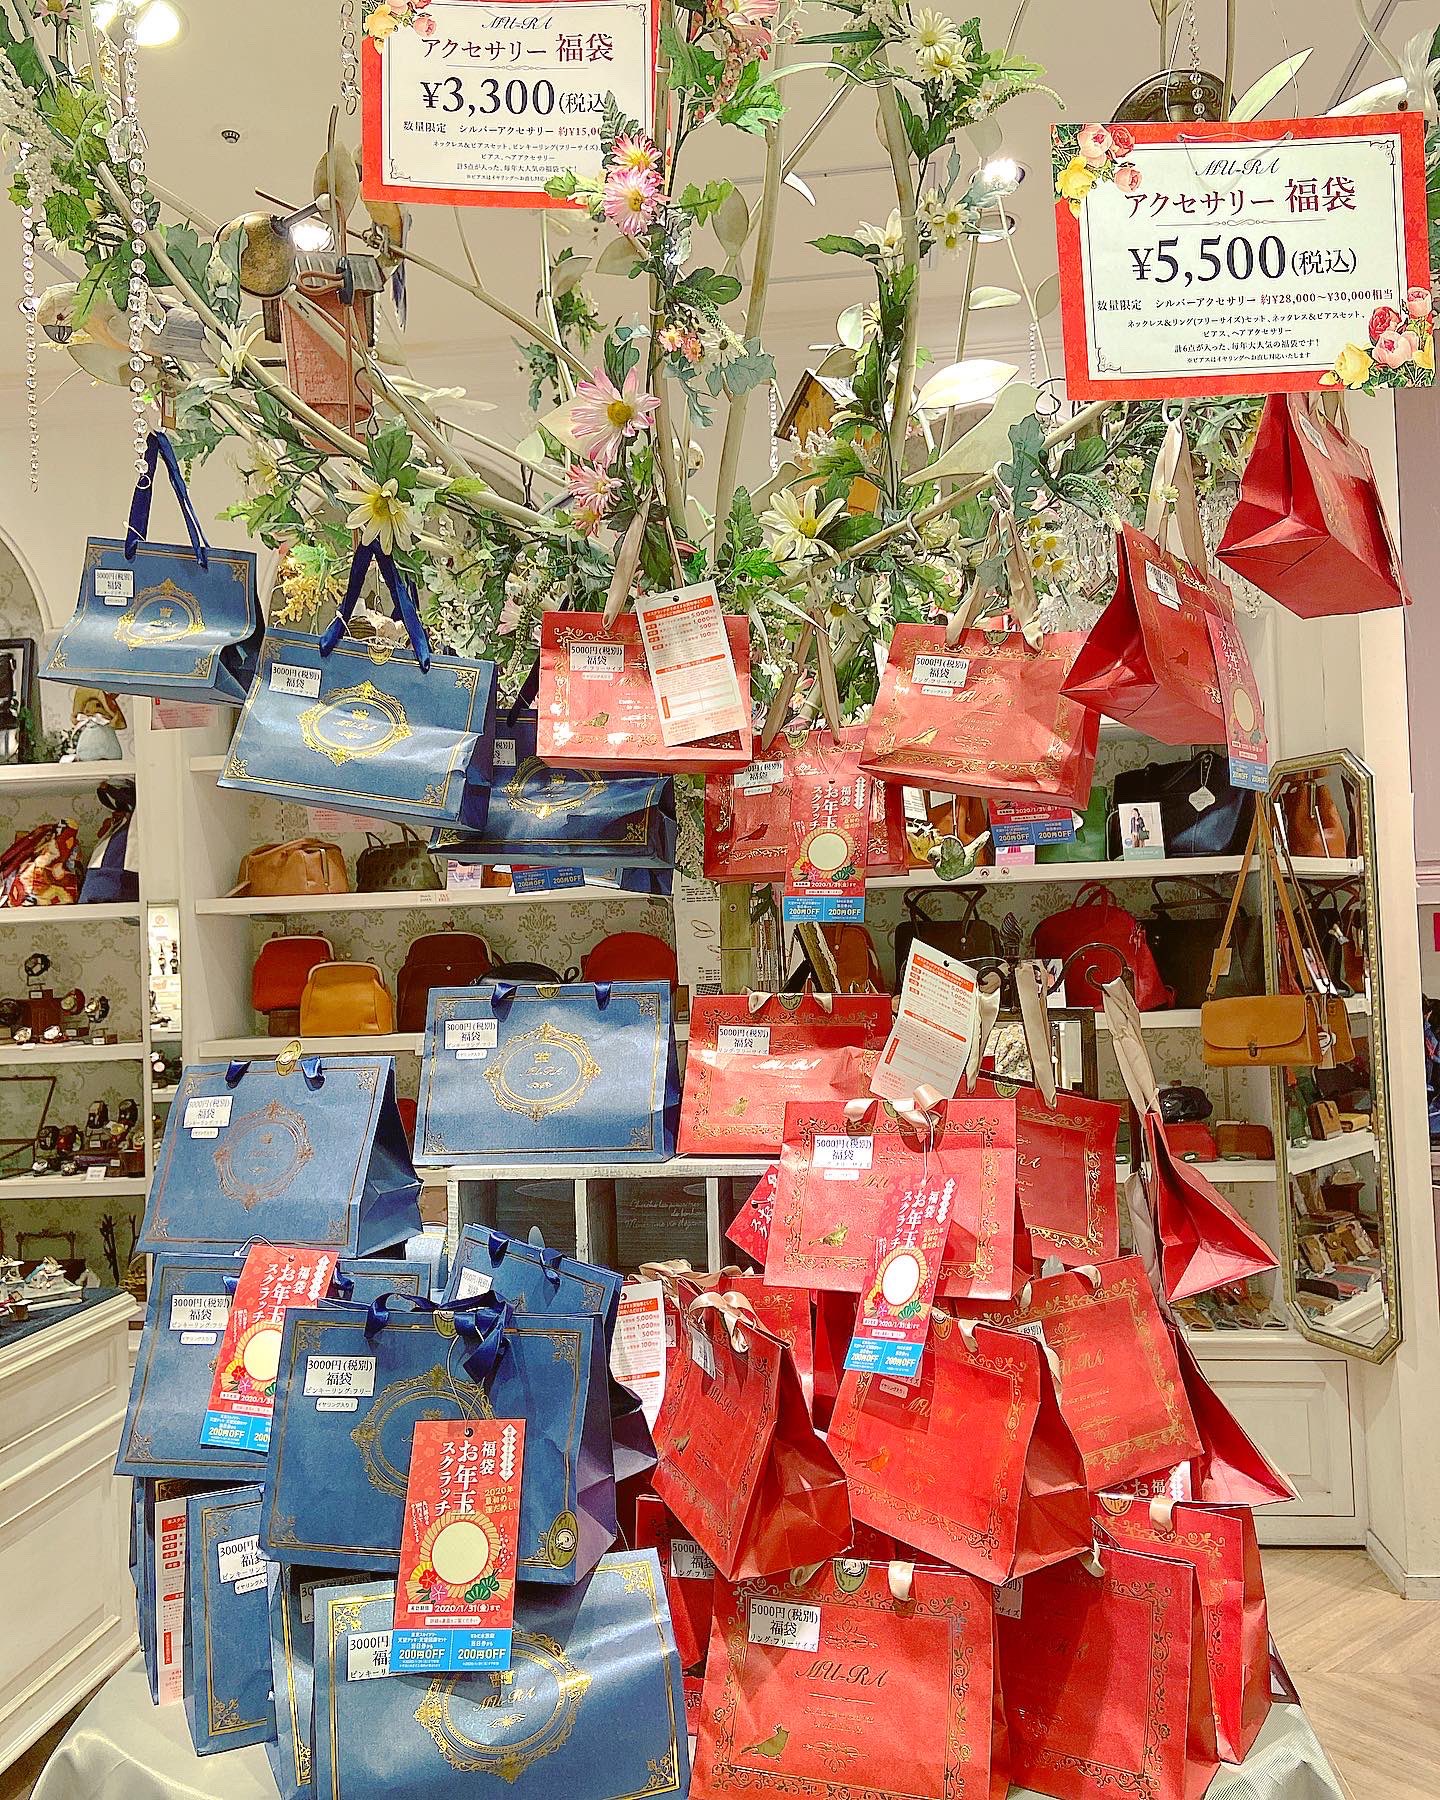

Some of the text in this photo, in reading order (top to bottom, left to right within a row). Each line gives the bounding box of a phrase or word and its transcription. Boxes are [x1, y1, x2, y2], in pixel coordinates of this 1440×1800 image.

[421, 33, 614, 63] アクセサリー 福袋
[420, 76, 606, 117] ¥3,300(税込
[403, 121, 447, 134] 数量限定
[459, 125, 554, 137] シルバーアクセサリー
[1124, 177, 1357, 218] アクセサリー 福袋
[1128, 235, 1358, 288] ¥5,500(税込)
[1097, 299, 1142, 312] 数量限定
[1155, 296, 1256, 308] シルバーアクセサリー
[571, 646, 623, 656] 5000円(税別)
[916, 657, 967, 670] 5000円(税別)
[809, 786, 823, 831] スクラッチ
[820, 785, 839, 830] お年玉
[447, 1023, 496, 1032] 3000円(税別)
[719, 1028, 769, 1038] 5000円(税別)
[461, 1032, 481, 1041] 福袋
[734, 1038, 753, 1048] 福袋
[816, 1139, 872, 1149] 5000円(税別)
[832, 1149, 854, 1160] 福袋
[890, 1191, 913, 1250] スクラッチ
[902, 1190, 927, 1249] お年玉
[252, 1263, 278, 1324] スクラッチ
[267, 1264, 296, 1323] お年玉
[173, 1298, 231, 1308] 3000円(税別)
[190, 1309, 212, 1321] 福袋
[308, 1359, 373, 1371] 3000円(税別)
[326, 1372, 353, 1386] 福袋
[208, 1427, 245, 1438] 200円OFF
[480, 1441, 497, 1476] 福袋
[434, 1441, 456, 1517] スクラッチ
[451, 1440, 479, 1516] お年玉
[484, 1486, 514, 1497] 2020年
[219, 1539, 259, 1557] 3000円(
[672, 1543, 704, 1554] 5000円
[690, 1556, 716, 1570] 福袋
[434, 1604, 501, 1613] 2020/1/31(金)まで
[751, 1603, 818, 1624] 5000円(税別)
[770, 1620, 797, 1637] 福袋
[350, 1635, 389, 1651] 3000円
[399, 1649, 446, 1660] 200円OFF
[457, 1649, 506, 1660] 200円OFF
